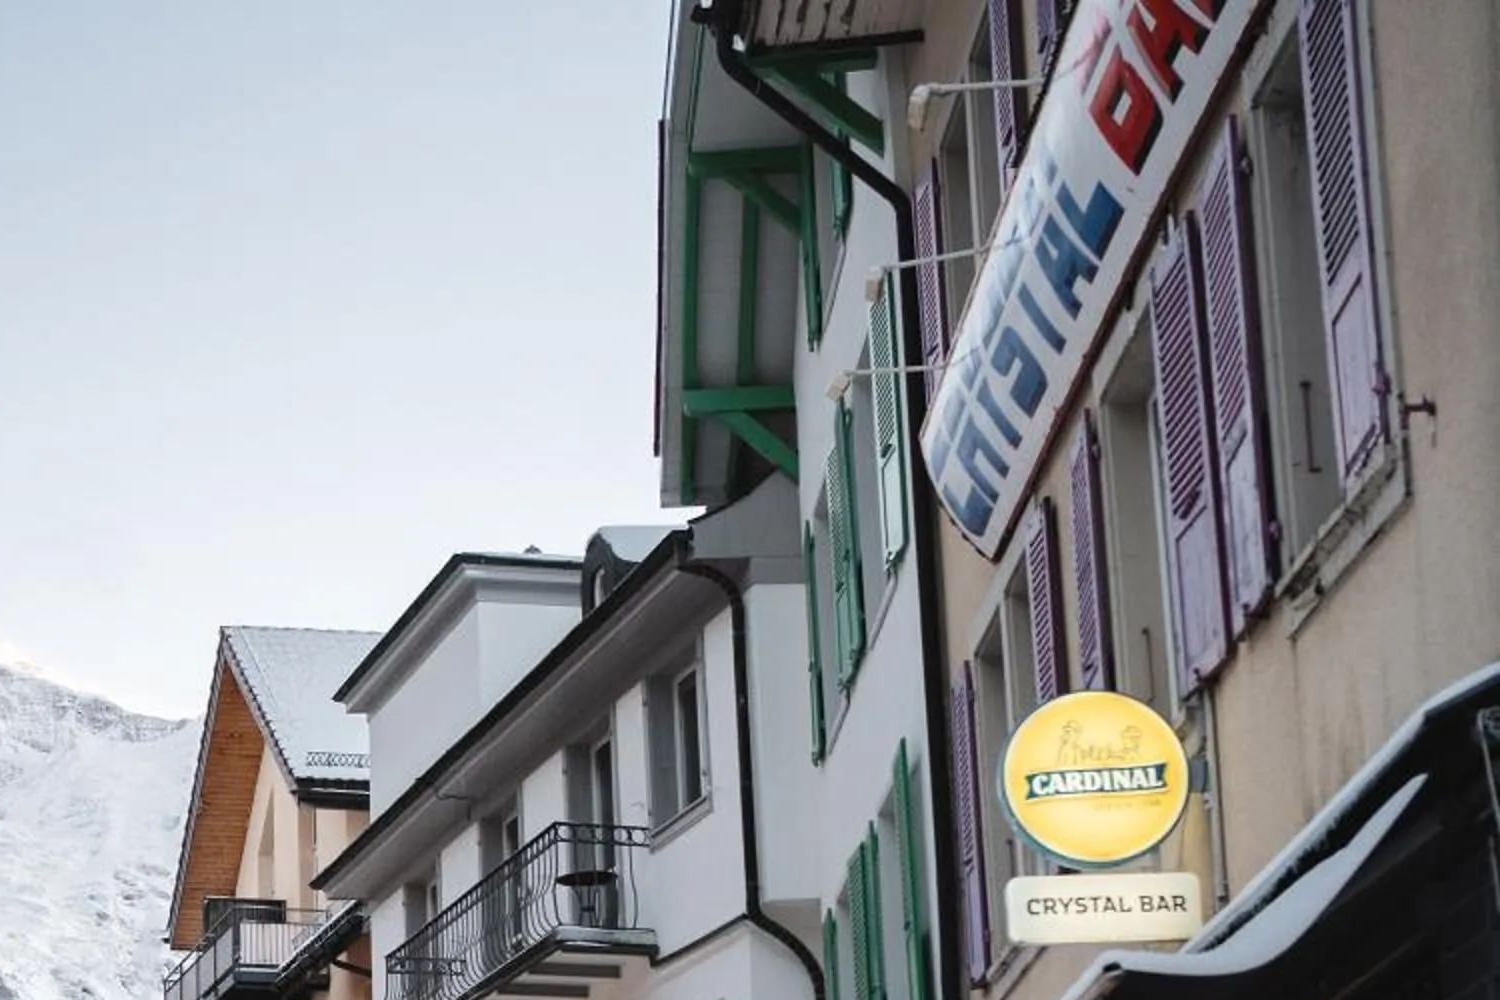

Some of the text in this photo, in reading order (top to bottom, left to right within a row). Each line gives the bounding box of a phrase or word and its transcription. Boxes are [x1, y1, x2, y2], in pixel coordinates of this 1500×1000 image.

[1032, 767, 1162, 795] CARDINAL
[1027, 895, 1188, 915] CRYSTAL BAR
